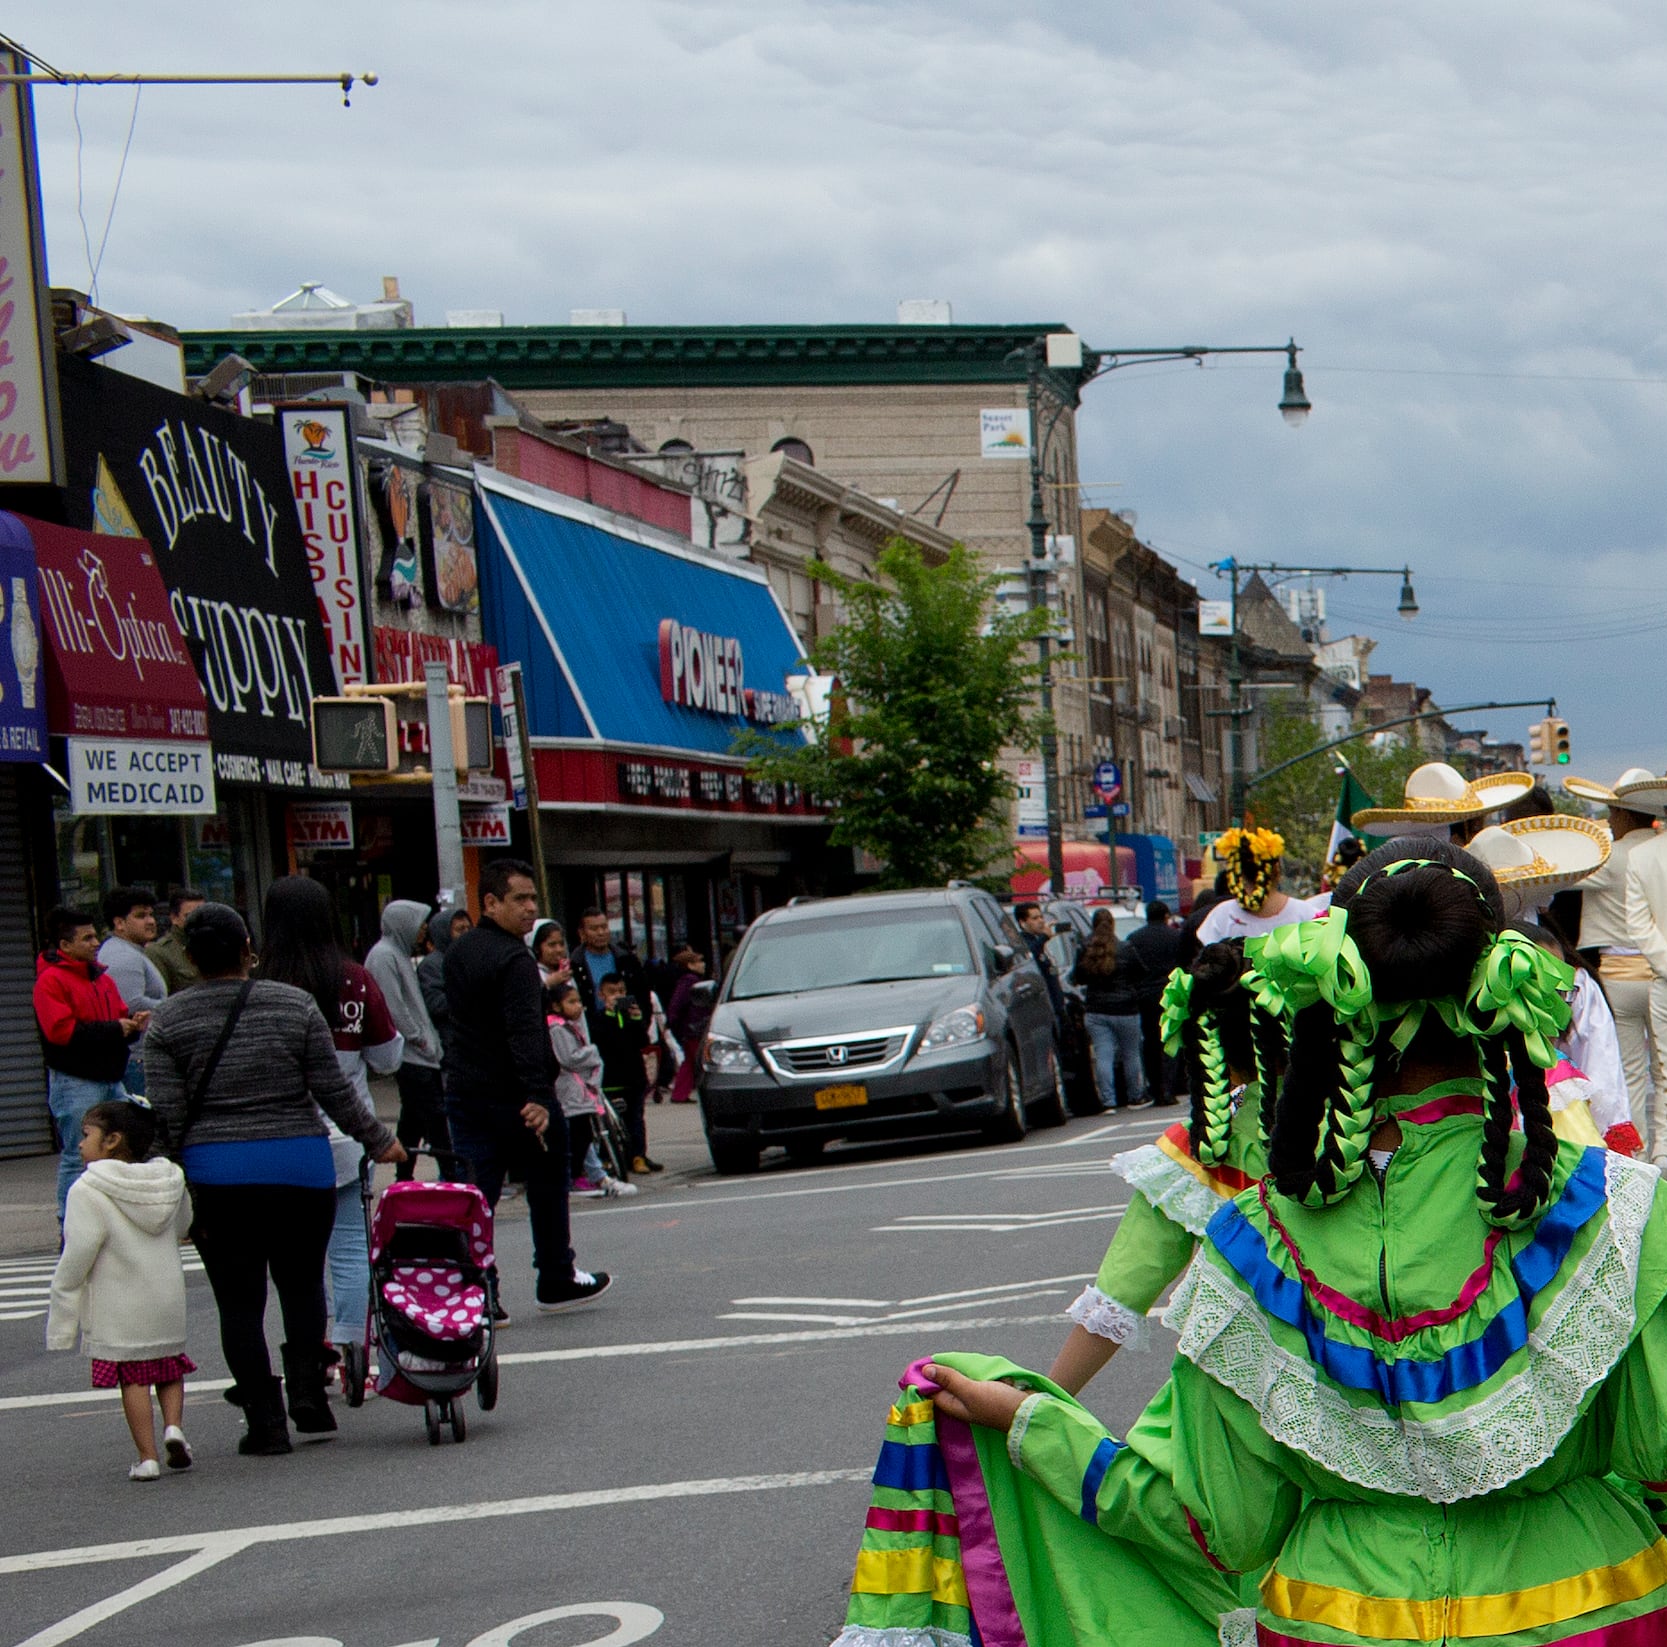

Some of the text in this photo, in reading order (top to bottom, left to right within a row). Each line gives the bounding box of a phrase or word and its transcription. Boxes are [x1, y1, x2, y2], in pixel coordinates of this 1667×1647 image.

[139, 418, 279, 579] BEAUTY
[325, 480, 362, 685] CUISIN
[666, 618, 749, 717] PIONEER
[84, 750, 202, 773] WE ACCEPT
[87, 782, 205, 804] MEDICAID
